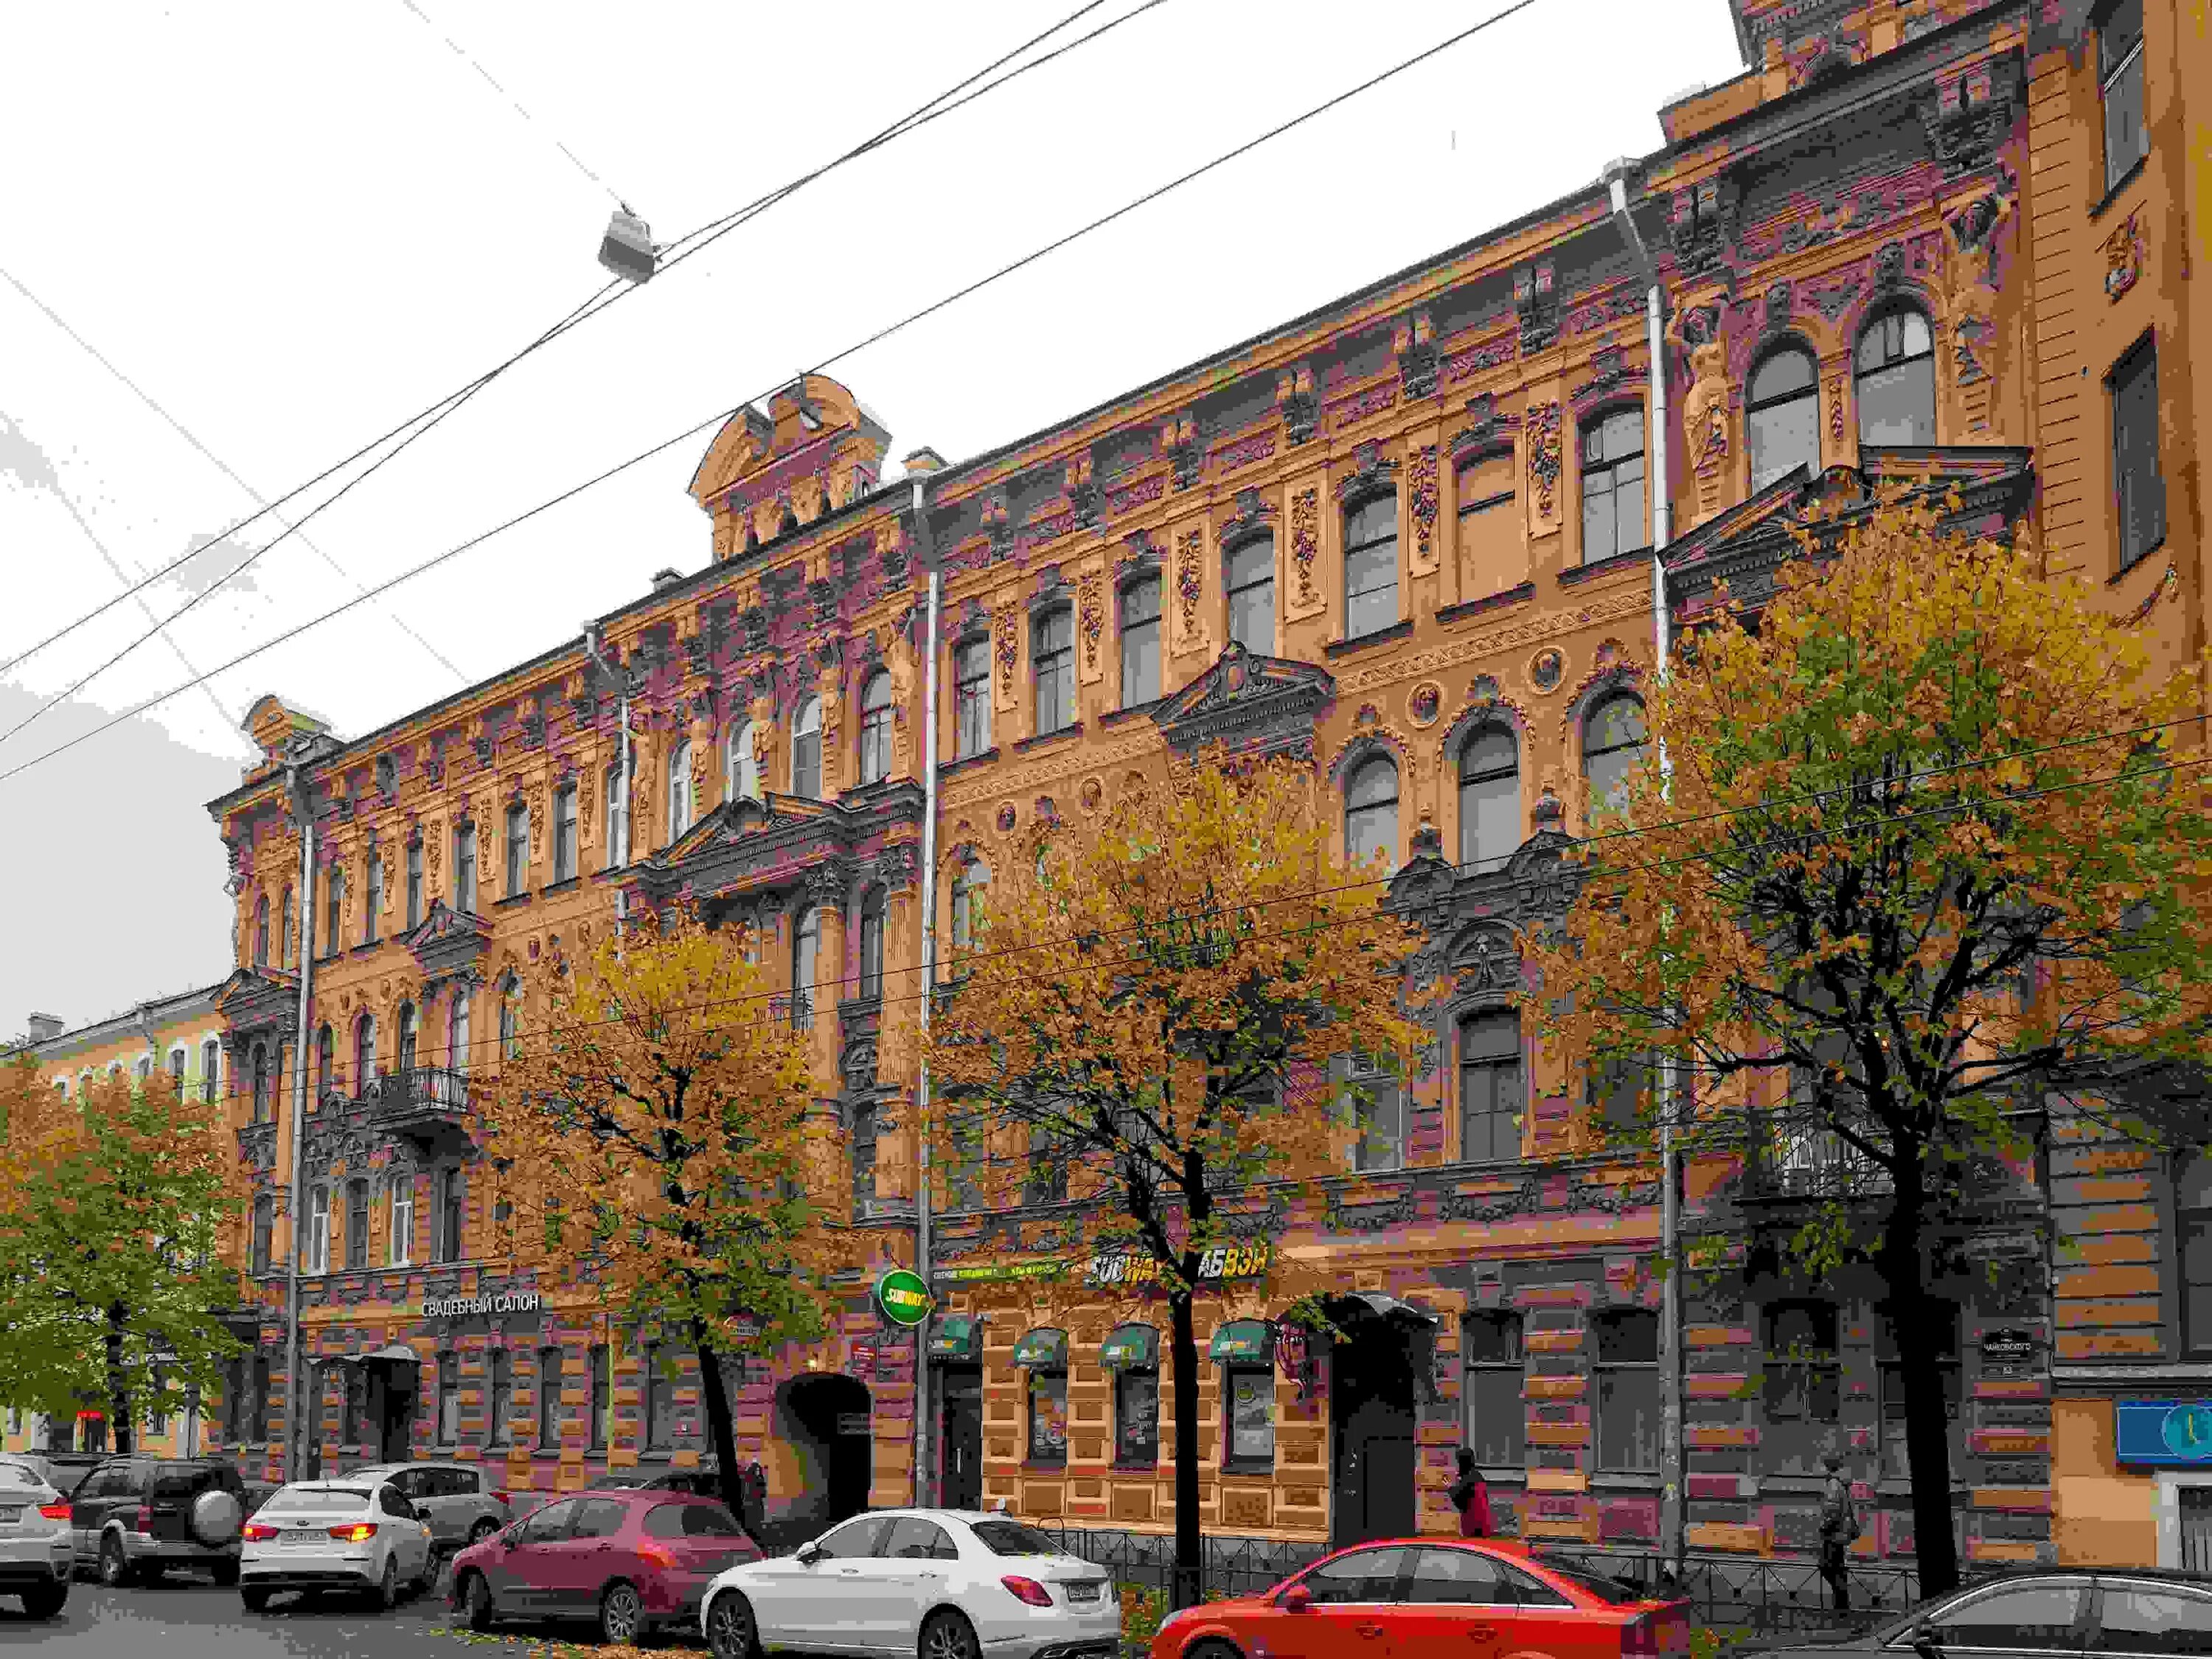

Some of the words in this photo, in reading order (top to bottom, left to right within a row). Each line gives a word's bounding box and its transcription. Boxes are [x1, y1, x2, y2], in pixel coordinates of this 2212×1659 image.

[421, 1296, 493, 1318] СВАДЕБНЫЙ
[495, 1294, 539, 1313] САЛОН
[885, 1287, 926, 1307] SUBWAY
